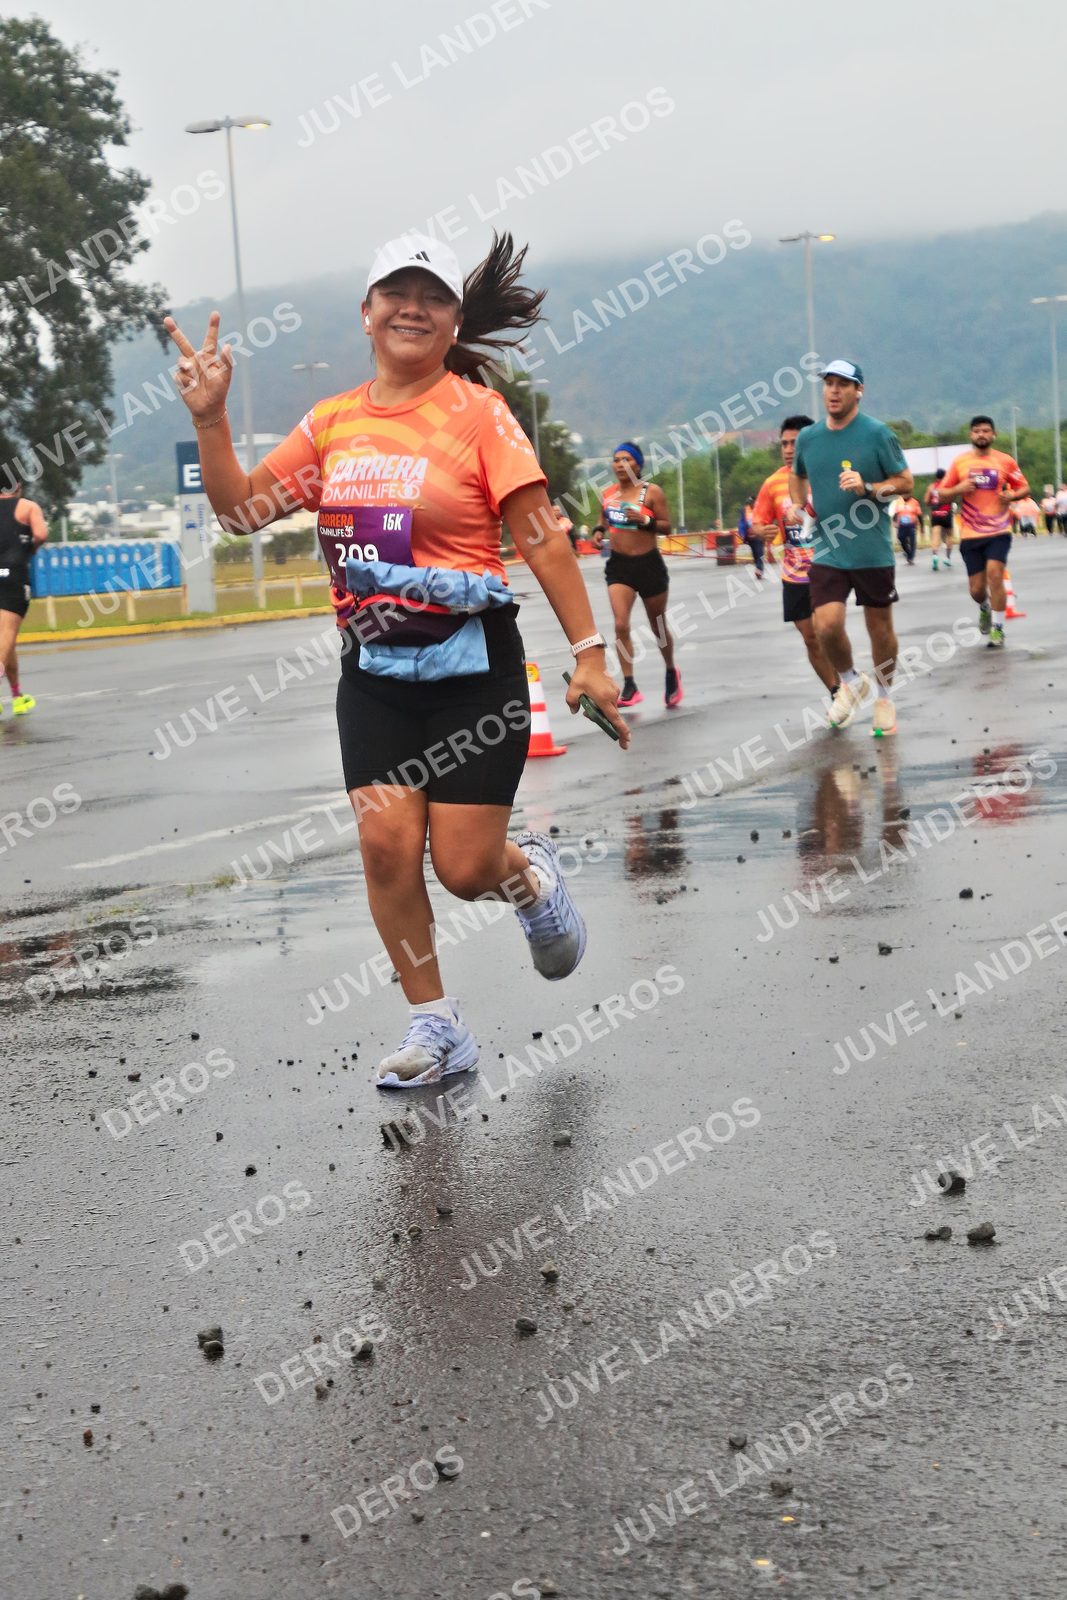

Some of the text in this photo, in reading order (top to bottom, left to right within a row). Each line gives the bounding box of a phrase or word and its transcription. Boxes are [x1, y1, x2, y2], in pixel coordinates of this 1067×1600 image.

[183, 463, 201, 488] E
[329, 454, 429, 484] CARRERA
[335, 543, 379, 567] 209
